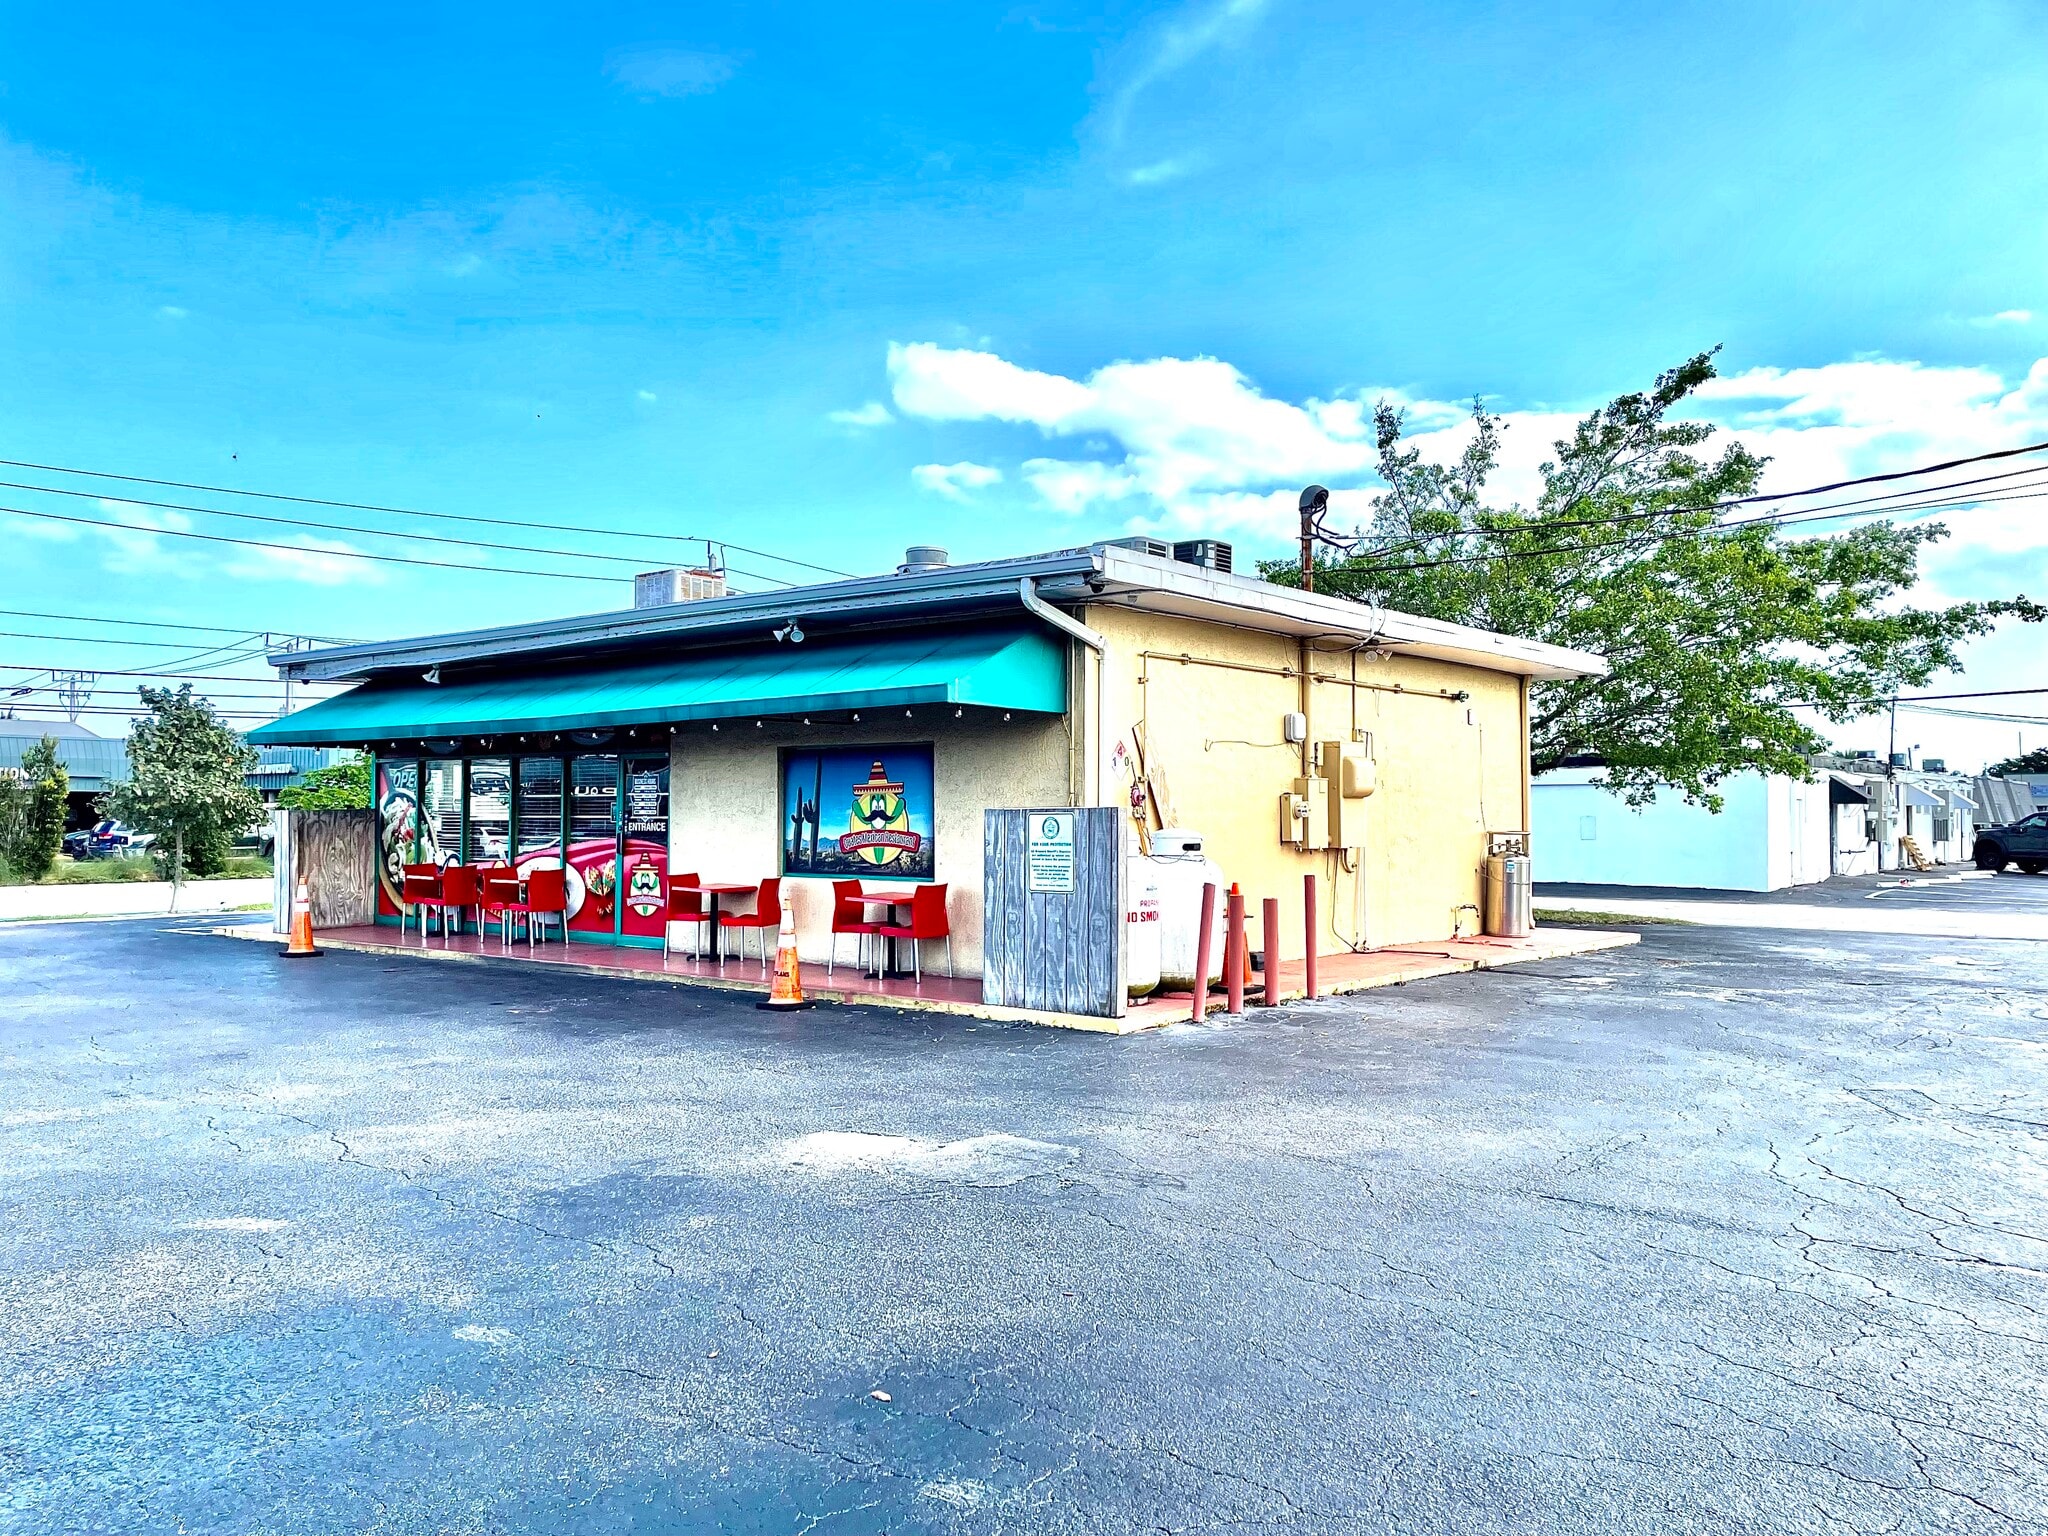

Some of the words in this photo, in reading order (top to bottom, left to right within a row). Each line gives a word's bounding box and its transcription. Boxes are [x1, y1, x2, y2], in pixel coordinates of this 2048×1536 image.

[1112, 756, 1117, 766] 1
[628, 822, 667, 831] ENTRANCE
[861, 831, 885, 845] Mexican
